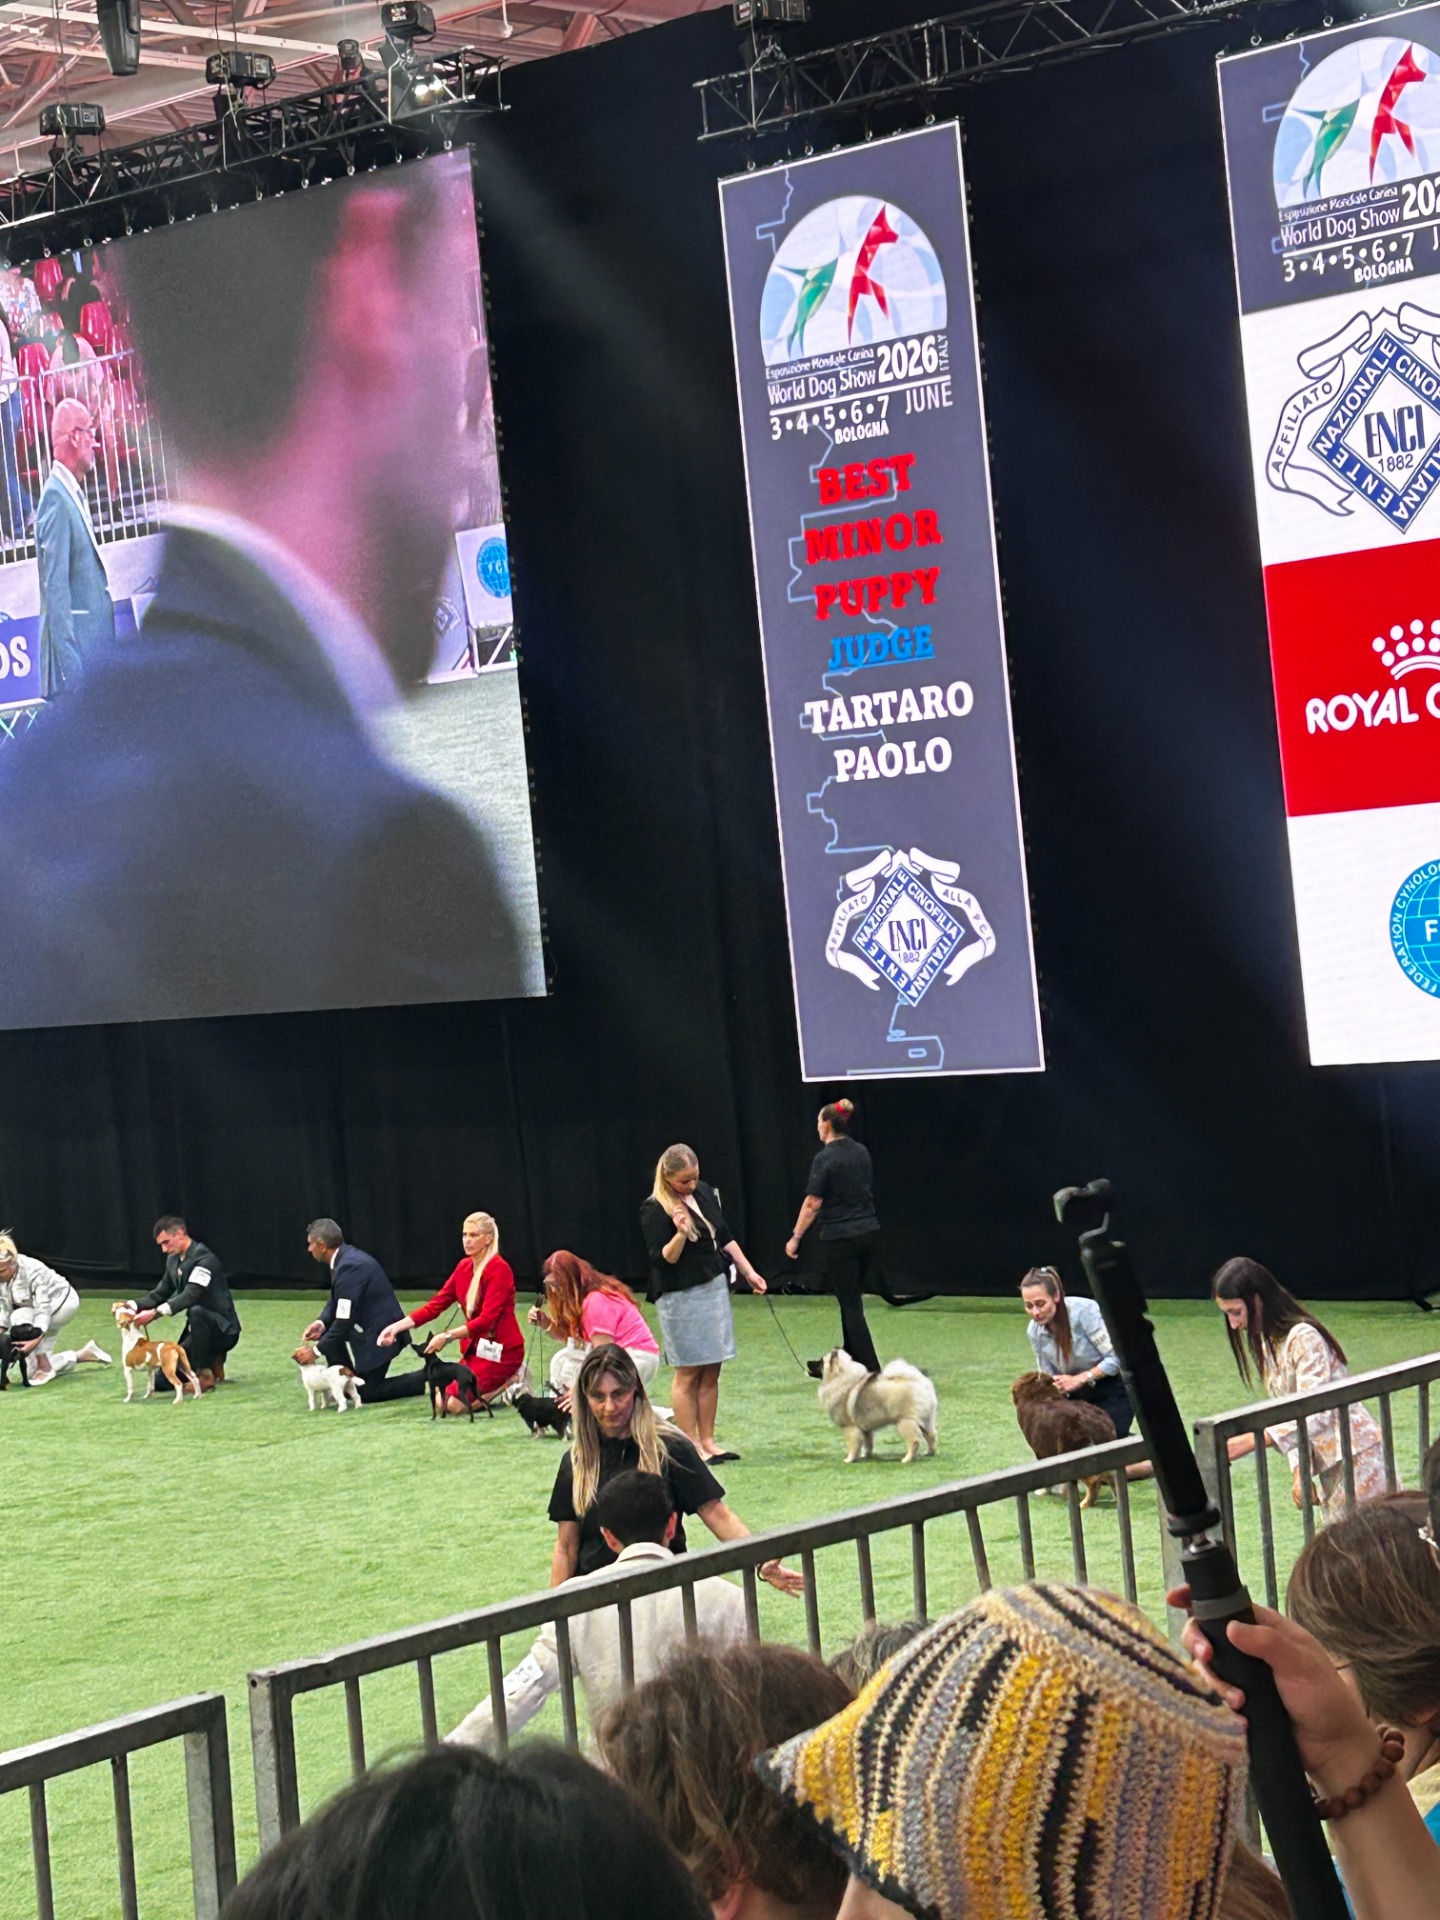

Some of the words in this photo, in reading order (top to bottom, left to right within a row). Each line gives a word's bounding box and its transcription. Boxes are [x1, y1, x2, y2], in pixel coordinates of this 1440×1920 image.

[1402, 176, 1440, 220] 20
[1281, 219, 1322, 247] World
[1326, 215, 1357, 239] Dog
[1360, 207, 1400, 231] Show
[1354, 257, 1414, 283] BOLOGNA
[877, 335, 939, 382] 2026
[937, 334, 950, 371] ITALY
[768, 379, 806, 405] World
[809, 376, 836, 399] Dog
[840, 369, 876, 392] Show
[905, 381, 953, 415] JUNE
[1315, 338, 1399, 456] NAZIONALE
[835, 420, 889, 444] BOLOGNA
[1270, 381, 1333, 474] AFFILIATO
[1364, 403, 1426, 458] ENCI
[818, 452, 915, 505] BEST
[1331, 448, 1394, 508] ENTE
[1378, 453, 1414, 474] 1882
[804, 508, 943, 565] MINOR
[814, 566, 940, 621] PUPPY
[828, 624, 935, 671] JUDGE
[804, 680, 974, 734] TARTARO
[1305, 686, 1420, 735] ROYAL
[833, 736, 952, 783] PAOLO
[856, 870, 909, 947] NAZIONALE
[942, 888, 972, 909] ALLA
[1395, 862, 1440, 909] CYNOLO
[888, 917, 927, 951] ENCI
[907, 882, 960, 941] CINOFILIA
[866, 943, 909, 988] ENTE
[907, 936, 953, 998] ITALIANA
[1392, 912, 1437, 994] FEDERATION
